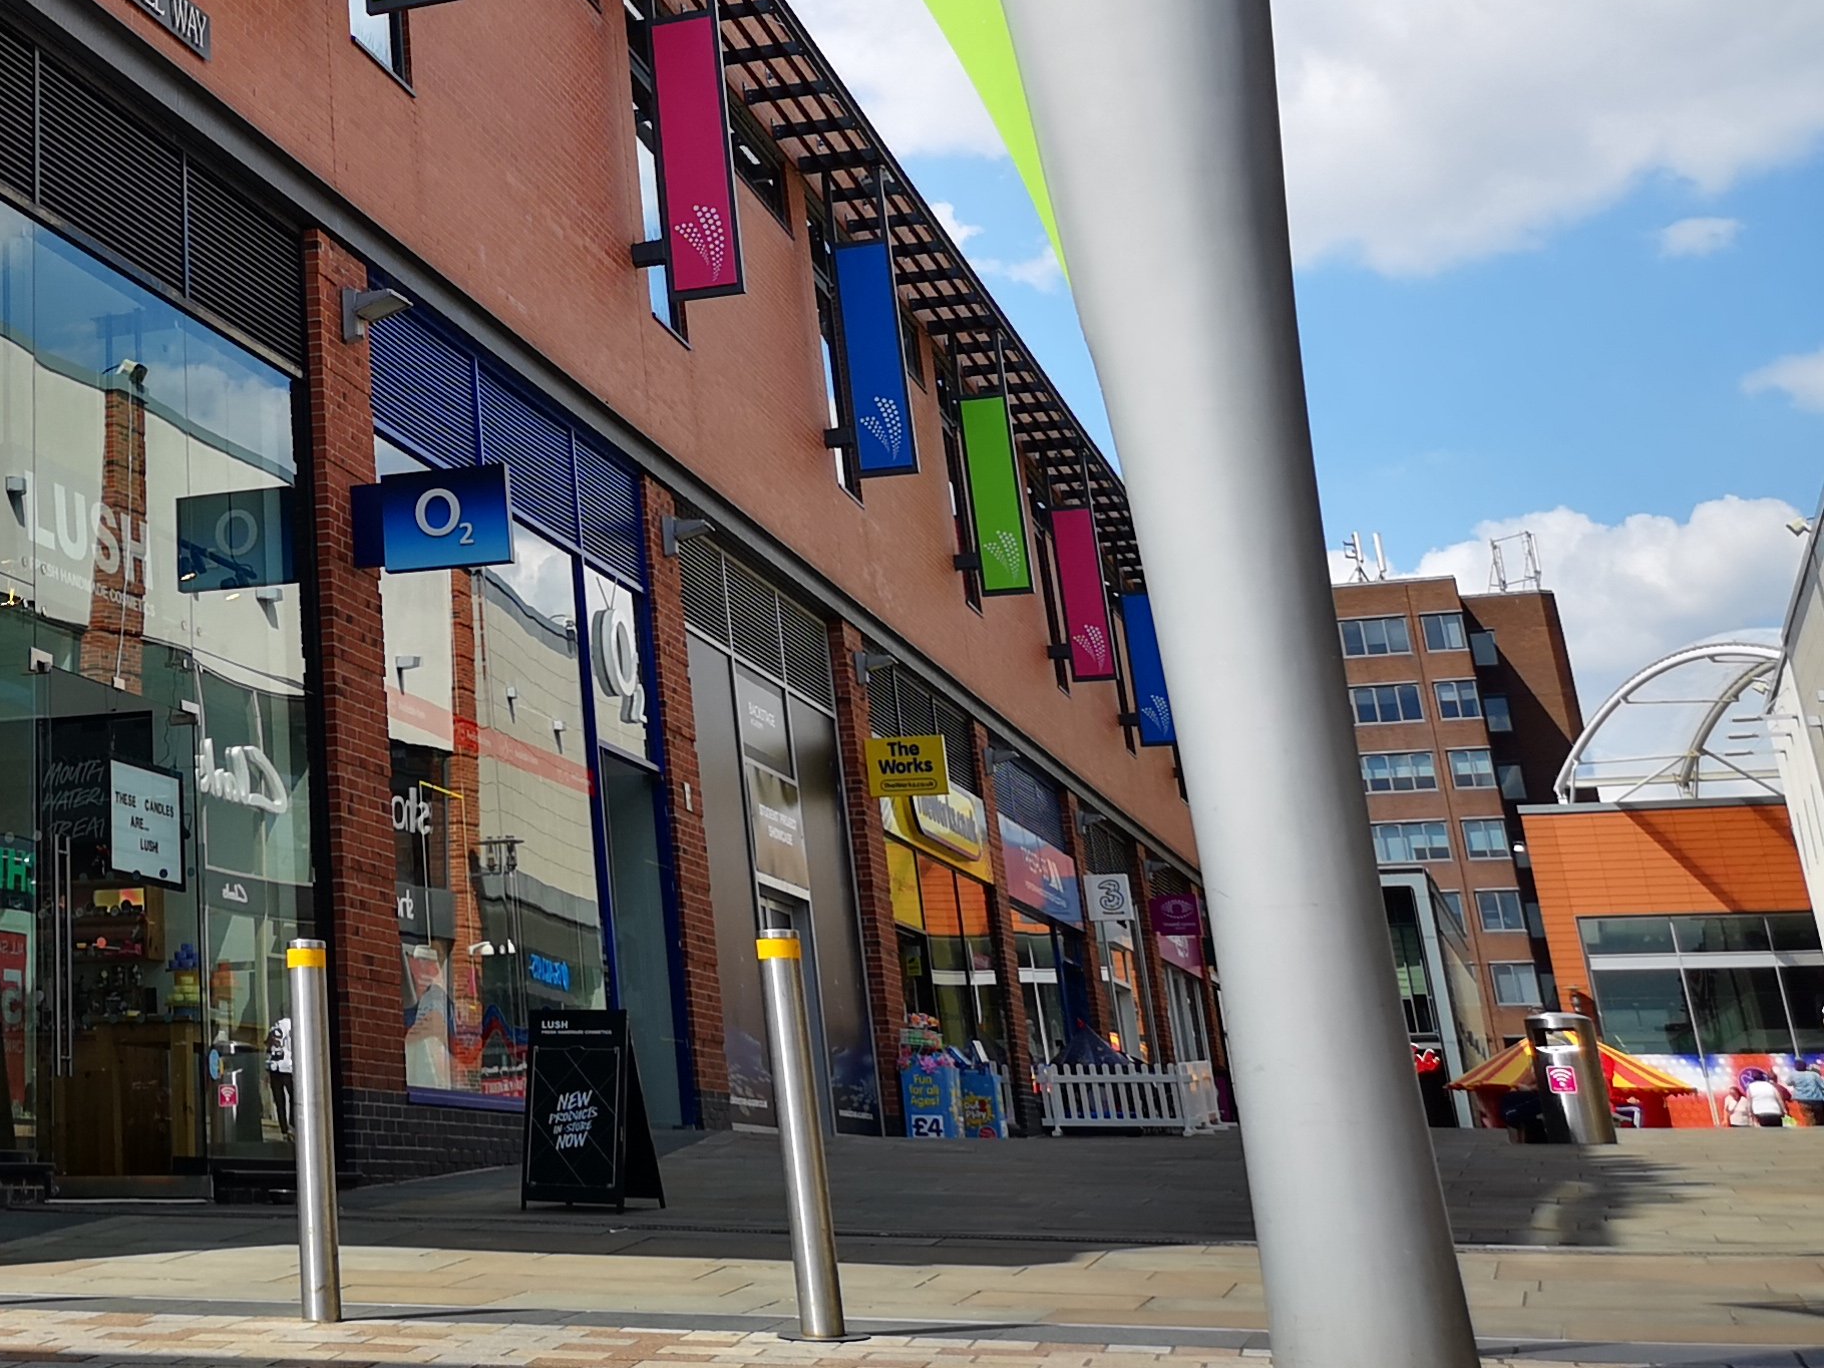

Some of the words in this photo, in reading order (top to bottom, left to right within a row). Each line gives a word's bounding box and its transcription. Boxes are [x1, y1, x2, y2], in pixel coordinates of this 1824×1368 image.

[415, 488, 474, 545] O2
[24, 470, 153, 590] LUSH
[886, 740, 920, 757] The
[878, 758, 934, 775] Works
[114, 790, 137, 808] THESE
[144, 799, 175, 818] CANDLES
[541, 1020, 569, 1029] LUSH
[556, 1089, 593, 1112] NEW
[548, 1106, 598, 1125] PRODUCTS
[912, 1117, 943, 1137] £4
[555, 1131, 588, 1151] NOW
